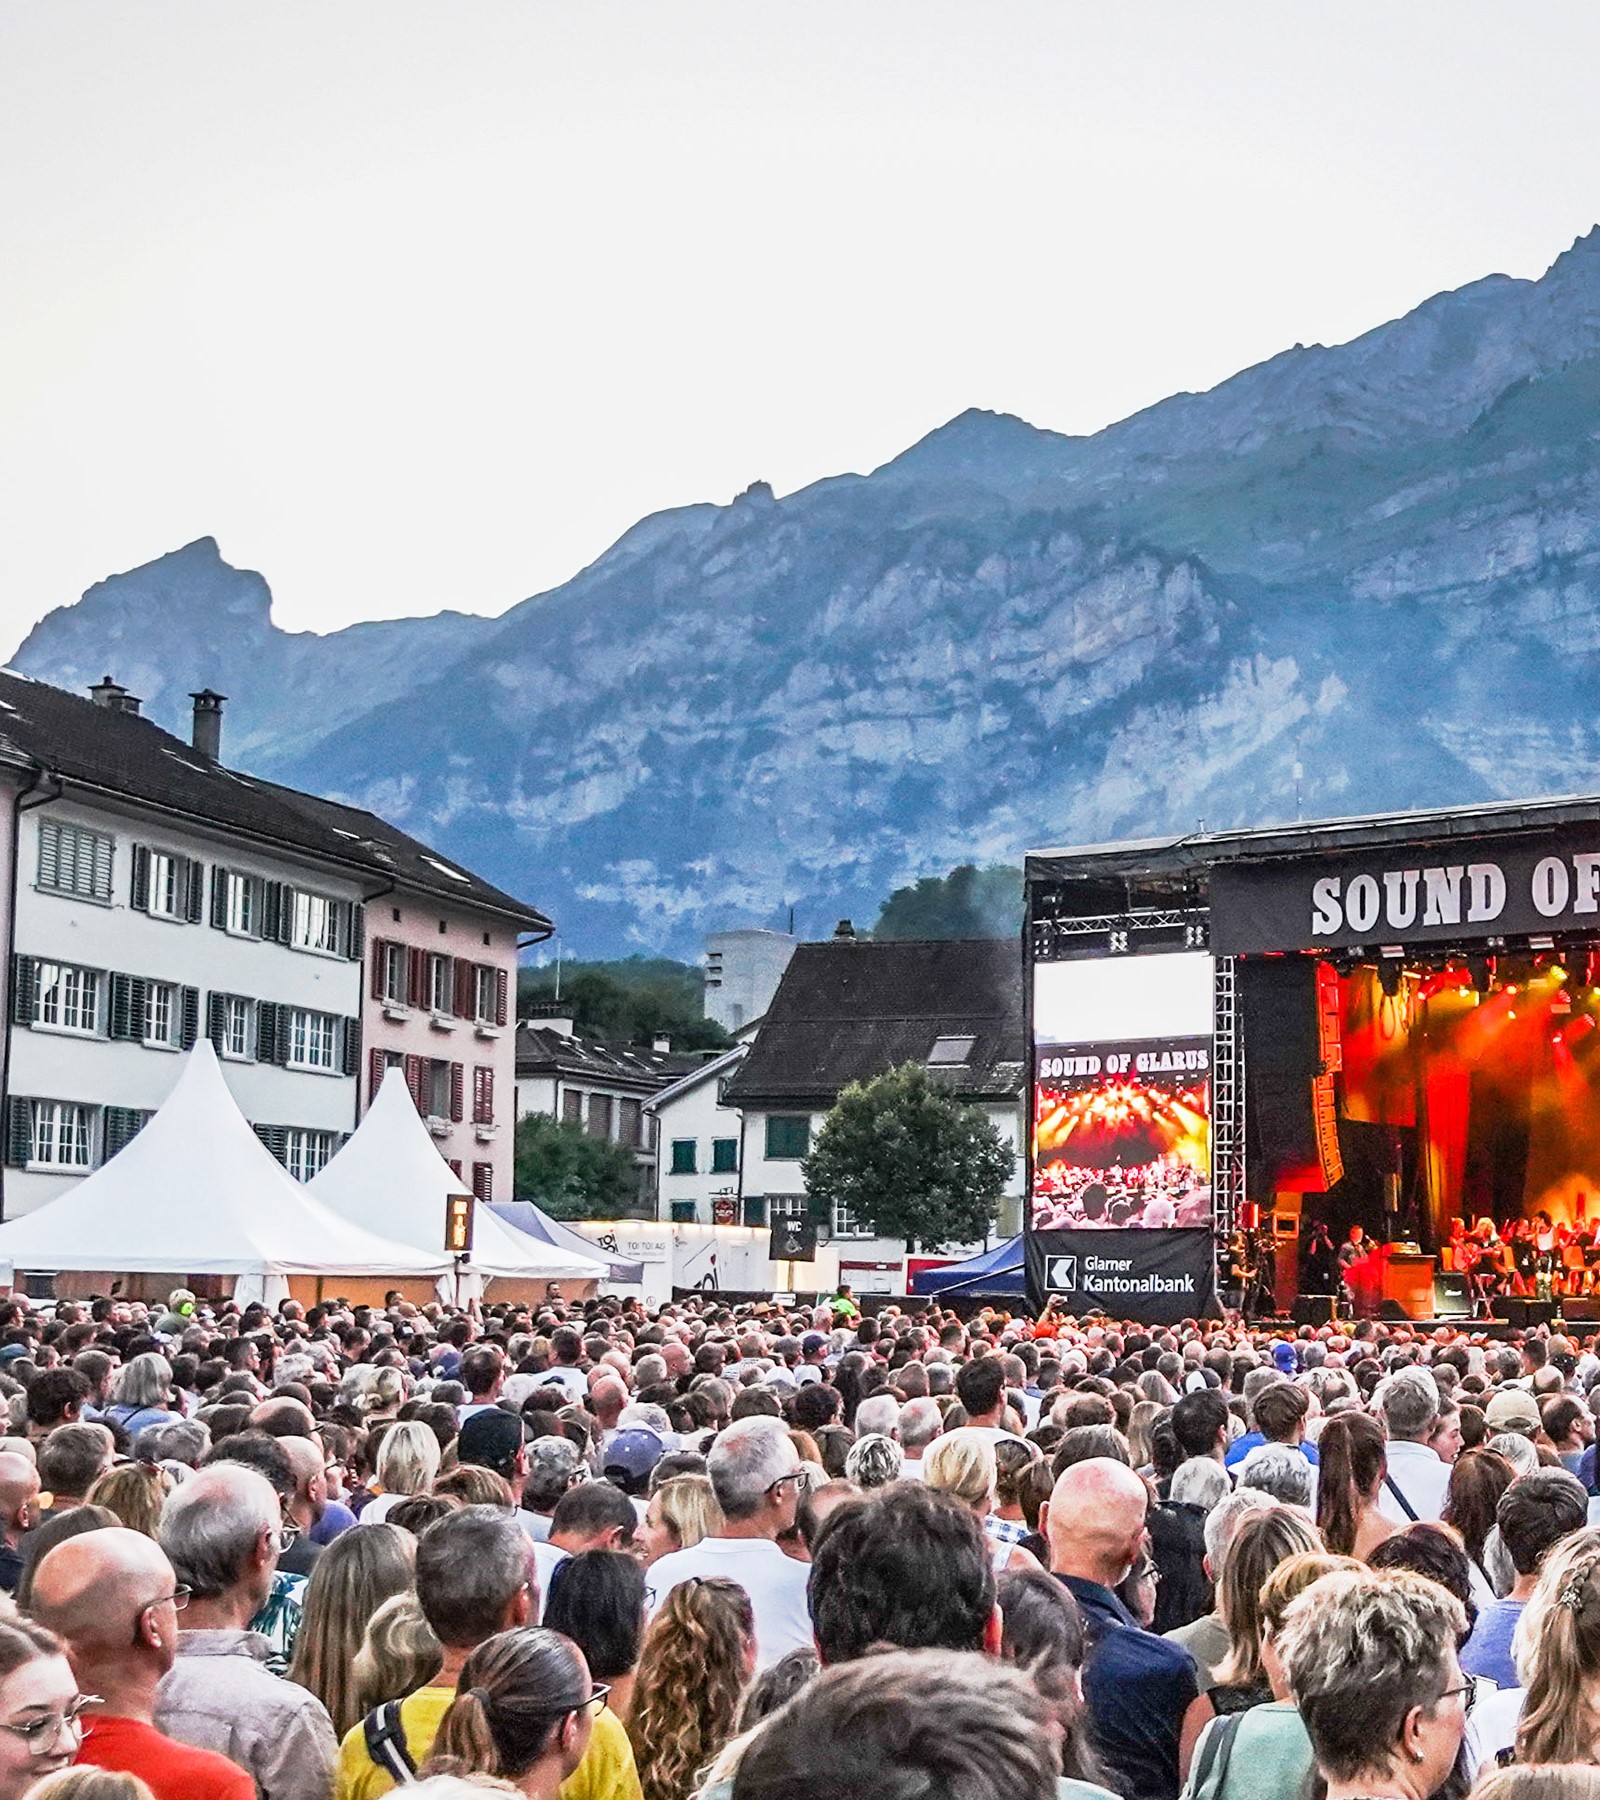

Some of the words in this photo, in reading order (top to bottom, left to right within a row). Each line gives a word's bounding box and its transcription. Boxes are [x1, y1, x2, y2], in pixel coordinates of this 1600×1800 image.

[1312, 862, 1506, 935] SOUND
[1040, 1055, 1101, 1078] SOUND
[1106, 1053, 1131, 1074] OF
[1136, 1050, 1209, 1073] GLARUS
[787, 1221, 802, 1232] WC
[1085, 1256, 1133, 1271] Glarner
[1083, 1273, 1195, 1293] Kantonalbank
